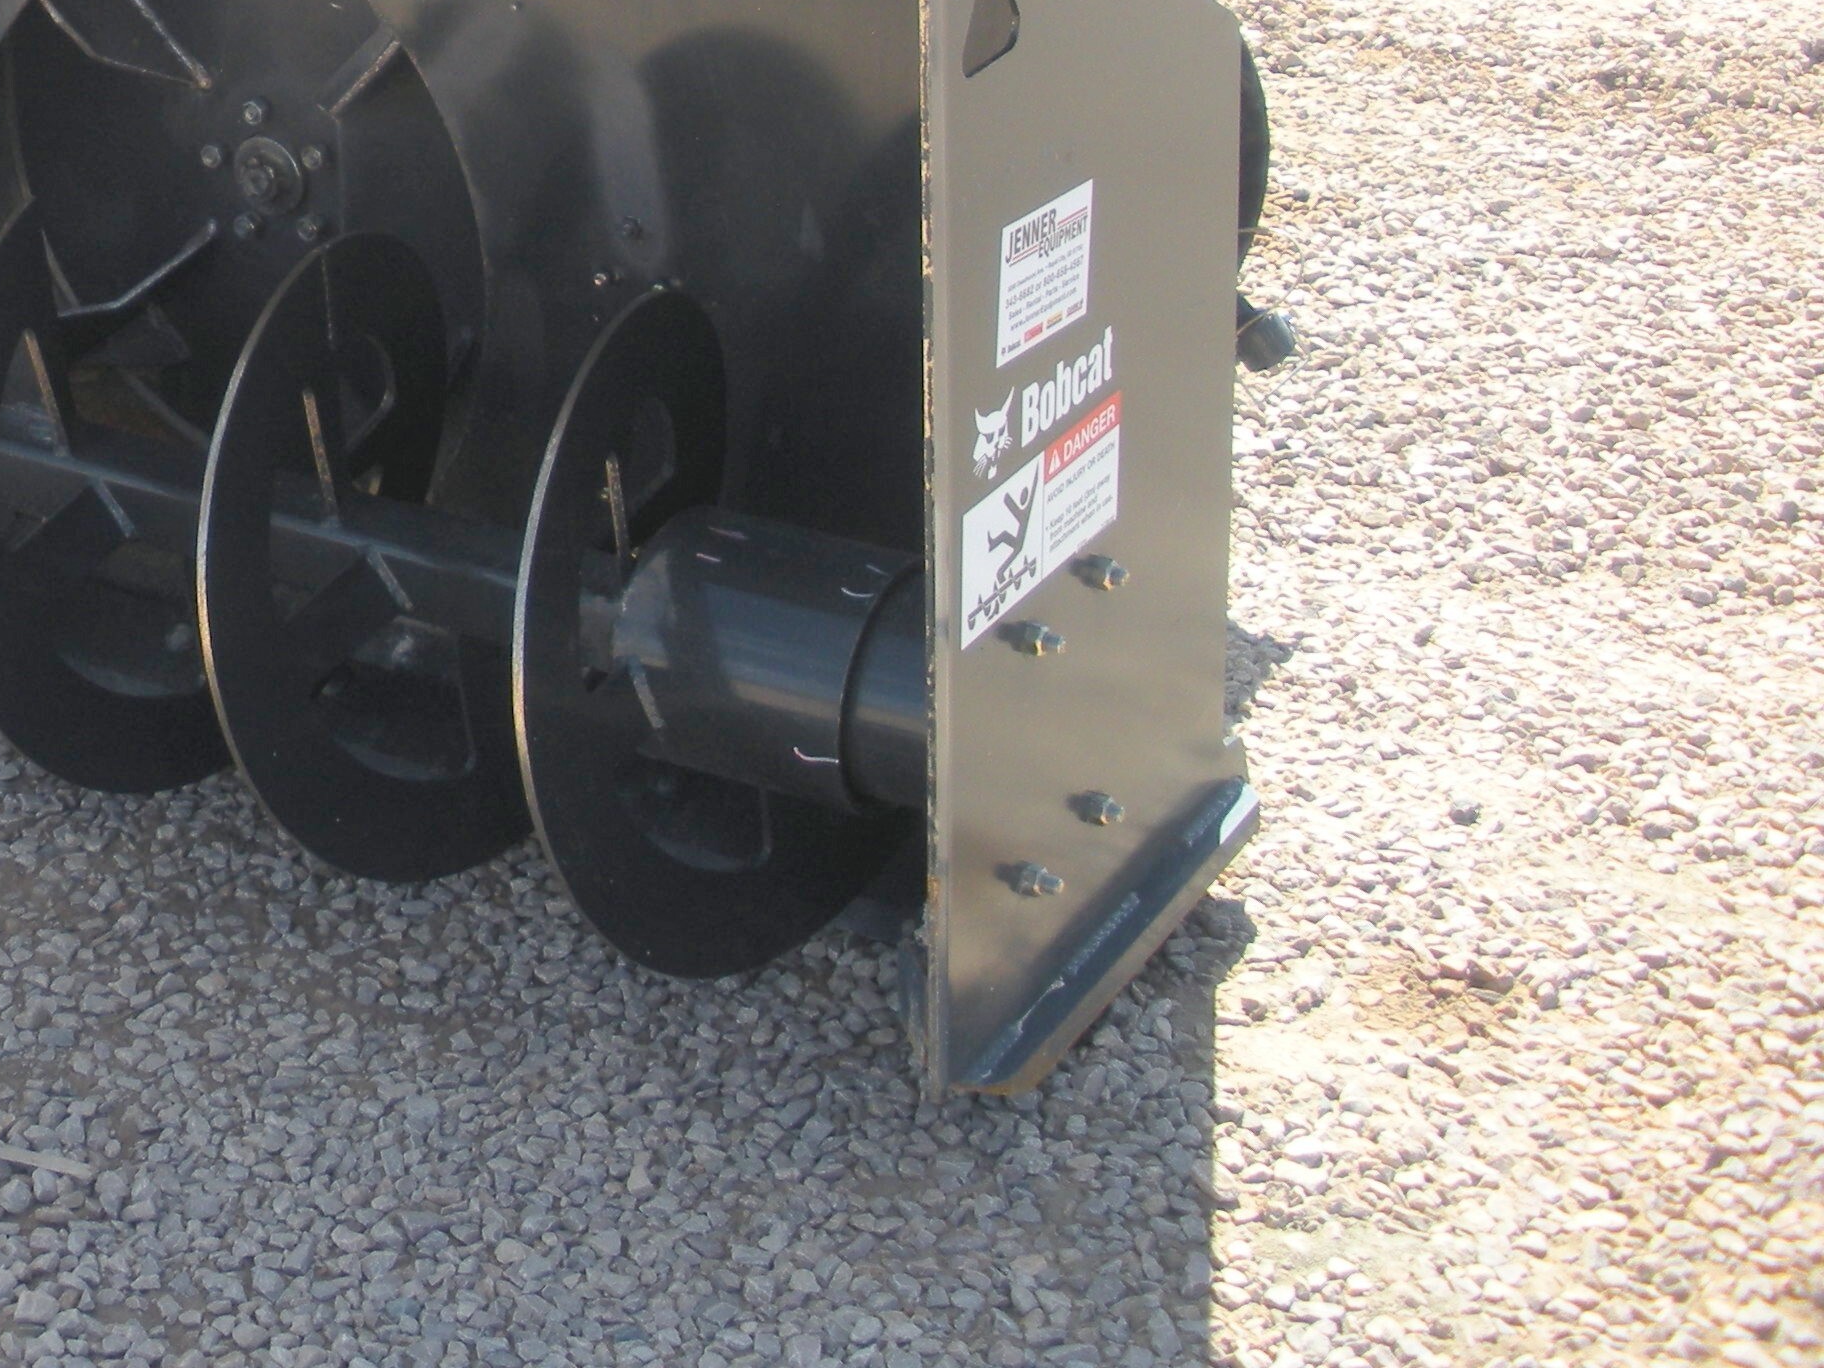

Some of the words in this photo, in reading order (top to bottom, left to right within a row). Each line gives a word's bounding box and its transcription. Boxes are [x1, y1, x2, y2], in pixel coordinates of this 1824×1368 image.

[1005, 208, 1057, 264] JENNER
[1038, 214, 1088, 259] EQUIPMENT
[1021, 325, 1113, 448] Bobcat
[1063, 403, 1116, 463] DANGER
[1047, 483, 1065, 504] AVOID
[1065, 465, 1086, 489] INJURY
[1087, 455, 1096, 470] OR
[1097, 442, 1115, 463] DEATH
